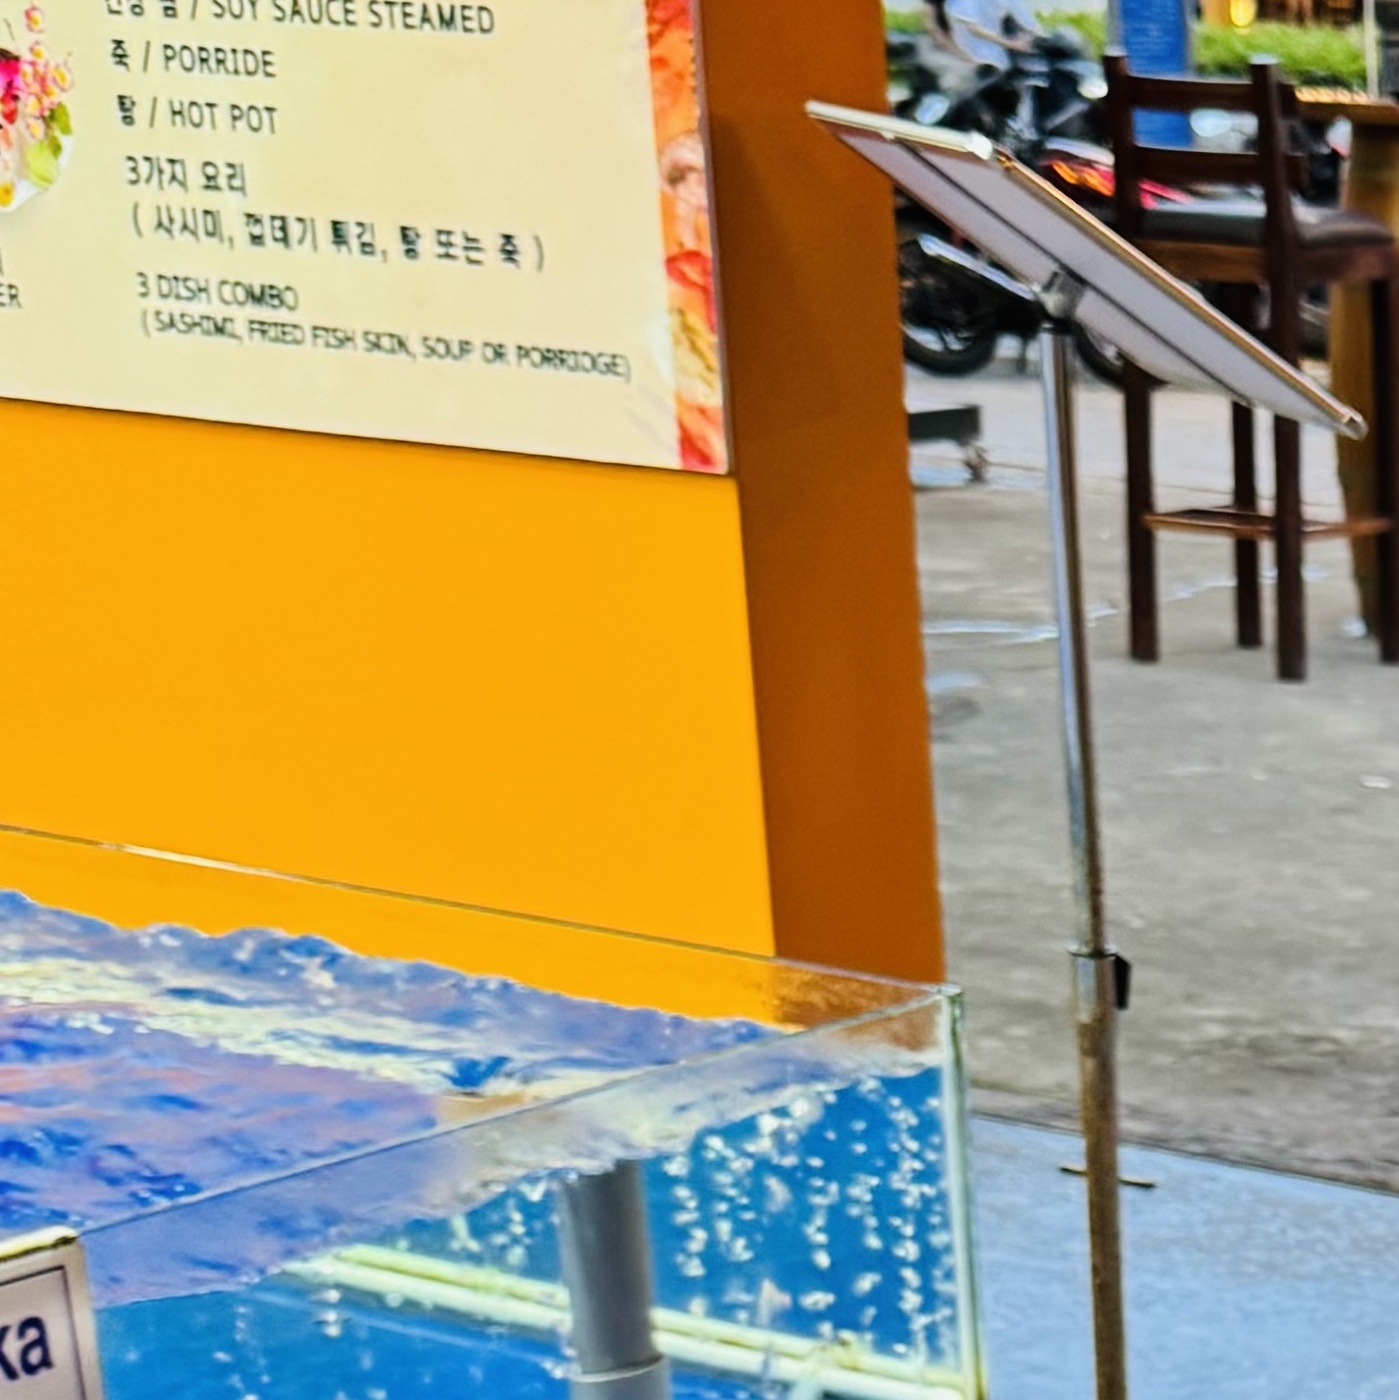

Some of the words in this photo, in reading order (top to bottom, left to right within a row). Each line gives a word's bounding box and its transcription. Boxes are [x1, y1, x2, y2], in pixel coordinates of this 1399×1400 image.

[212, 0, 258, 21] SOY
[273, 0, 358, 27] SAUCE
[367, 0, 495, 35] STEAMED
[110, 39, 130, 72] 죽
[162, 43, 277, 78] PORRIDE
[116, 94, 136, 127] 탕
[168, 99, 218, 131] HOT
[230, 103, 278, 134] POT
[125, 154, 189, 193] 3가지
[201, 160, 247, 198] 요리
[154, 204, 235, 250] 사시미,
[435, 228, 485, 267] 또는
[498, 232, 521, 270] 죽
[135, 271, 150, 299] 3
[156, 273, 212, 305] DISH
[217, 279, 300, 312] COMBO
[247, 318, 305, 346] FRIED
[311, 324, 359, 351] FISH
[421, 335, 473, 362] SOUP
[481, 340, 511, 367] OR
